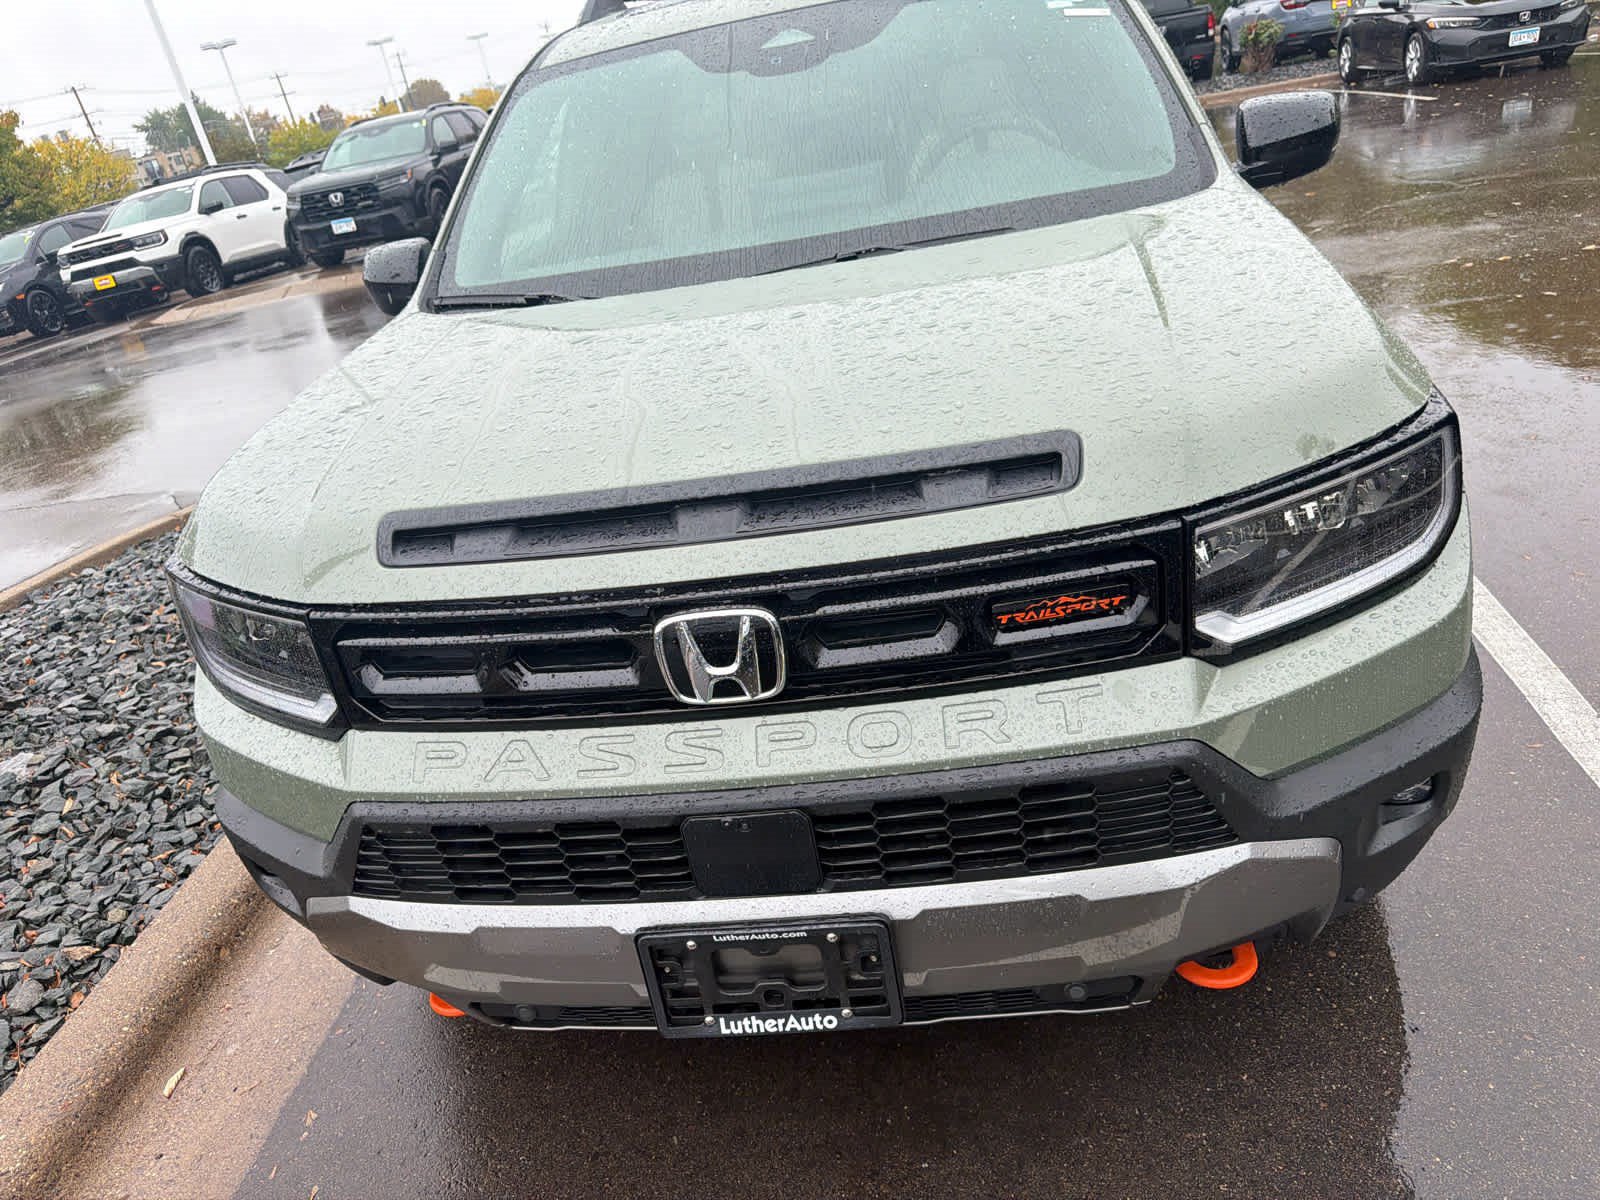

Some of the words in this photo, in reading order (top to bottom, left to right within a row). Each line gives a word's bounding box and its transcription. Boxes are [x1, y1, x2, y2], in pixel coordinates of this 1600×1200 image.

[997, 596, 1127, 624] TRAILSPORT
[411, 686, 1104, 784] PASSPORT
[713, 931, 807, 942] LutherAuto.com
[719, 1013, 838, 1034] LutherAuto
